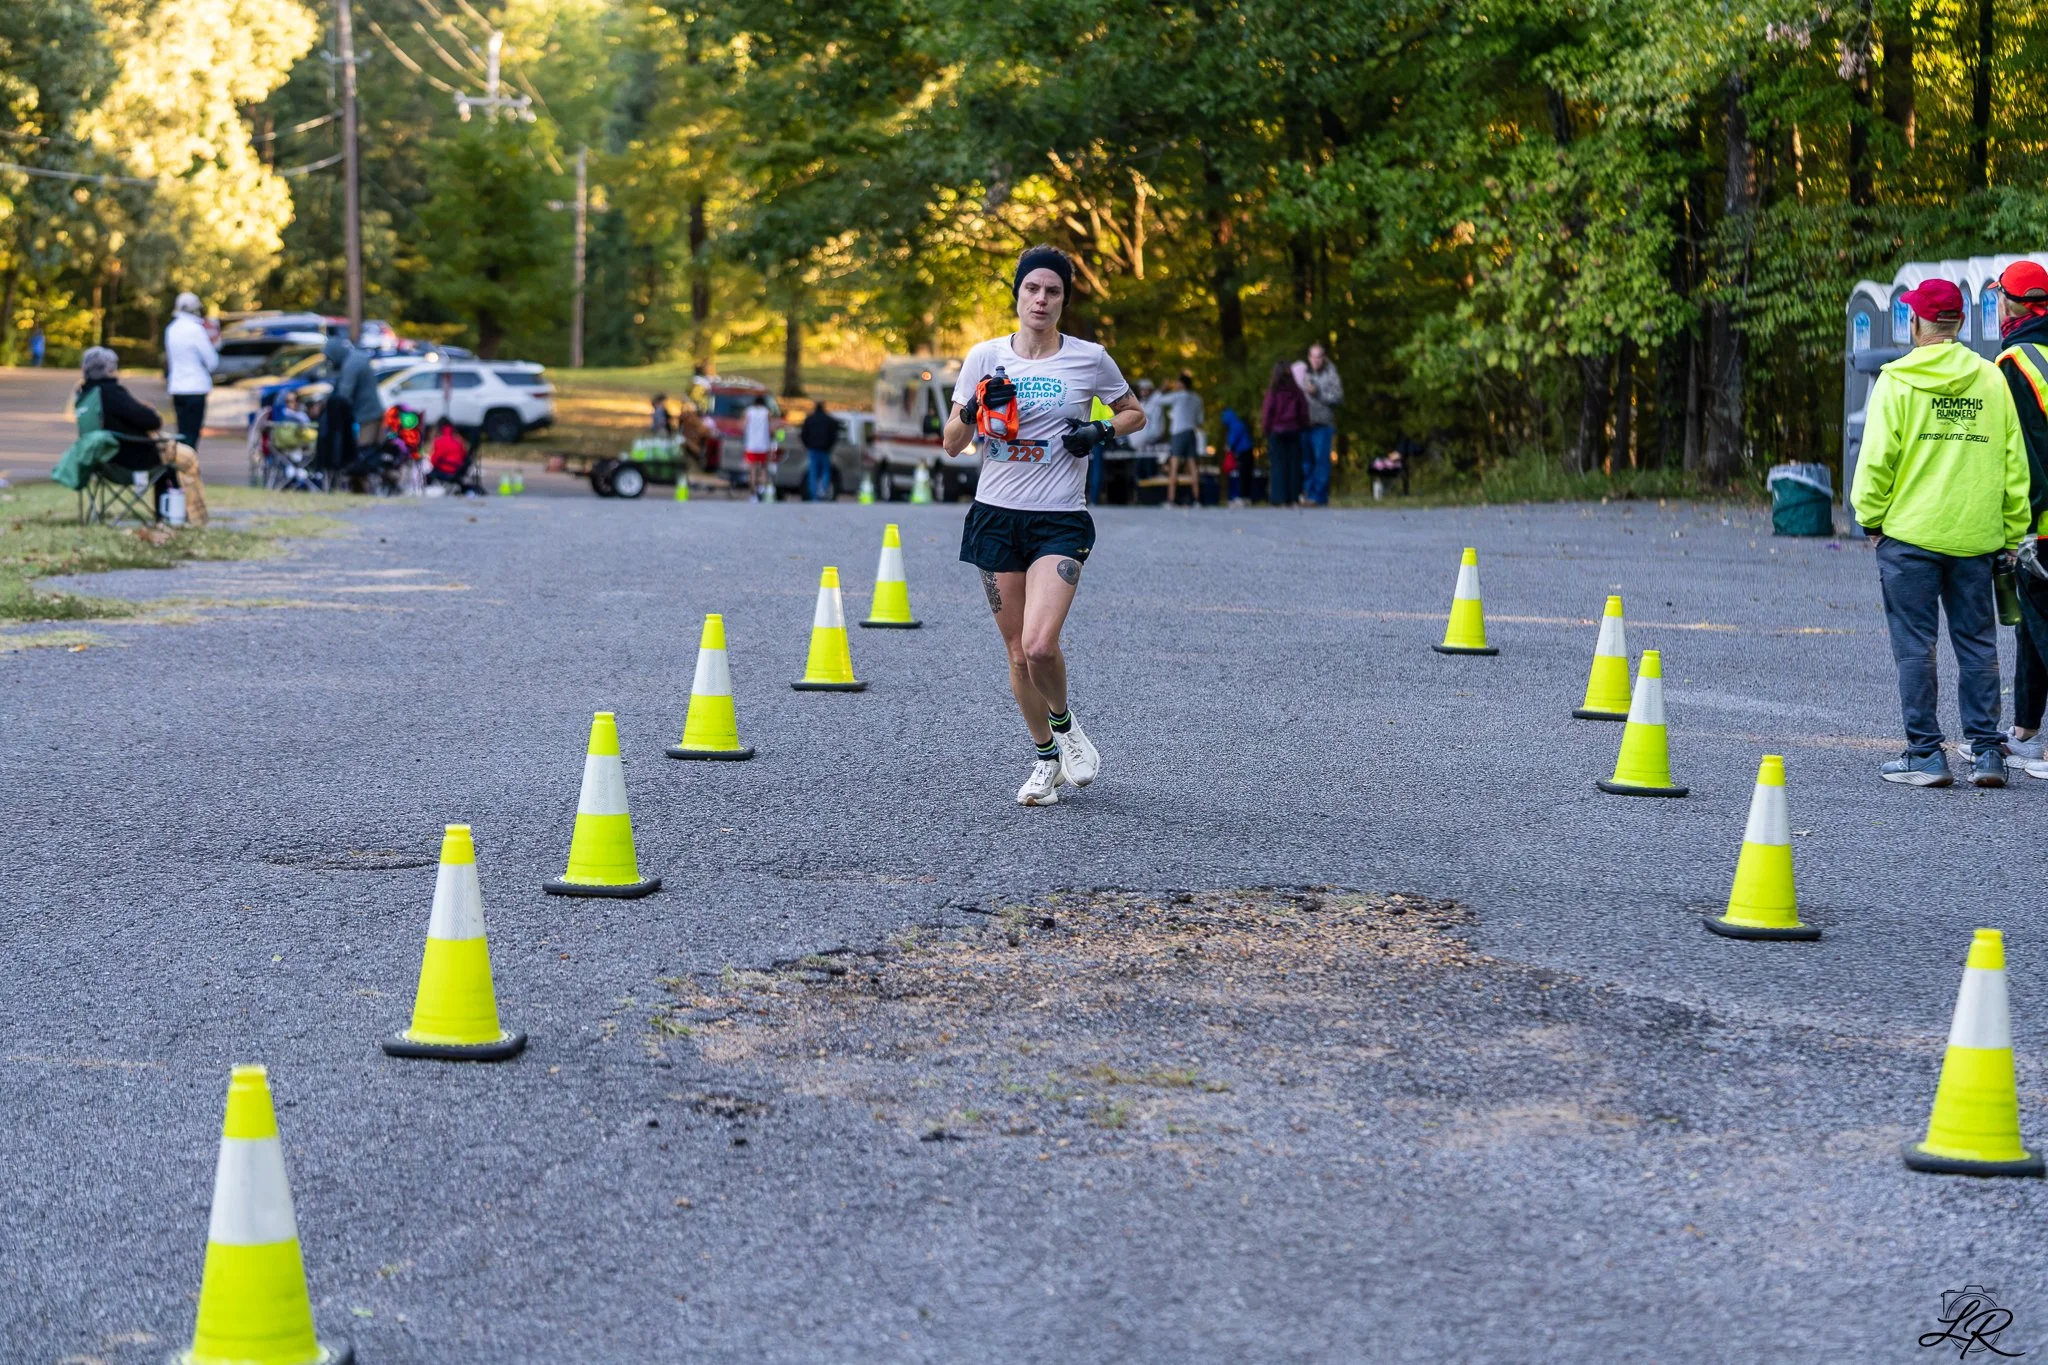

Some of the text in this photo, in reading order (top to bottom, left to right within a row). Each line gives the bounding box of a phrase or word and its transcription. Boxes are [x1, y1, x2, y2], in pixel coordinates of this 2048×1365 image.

[1032, 376, 1062, 384] AMERICA
[1932, 398, 1983, 410] MEMPHIS
[1936, 409, 1977, 418] RUNNERS
[1918, 433, 1990, 443] FINISH LINE CREW
[1007, 446, 1044, 462] 229
